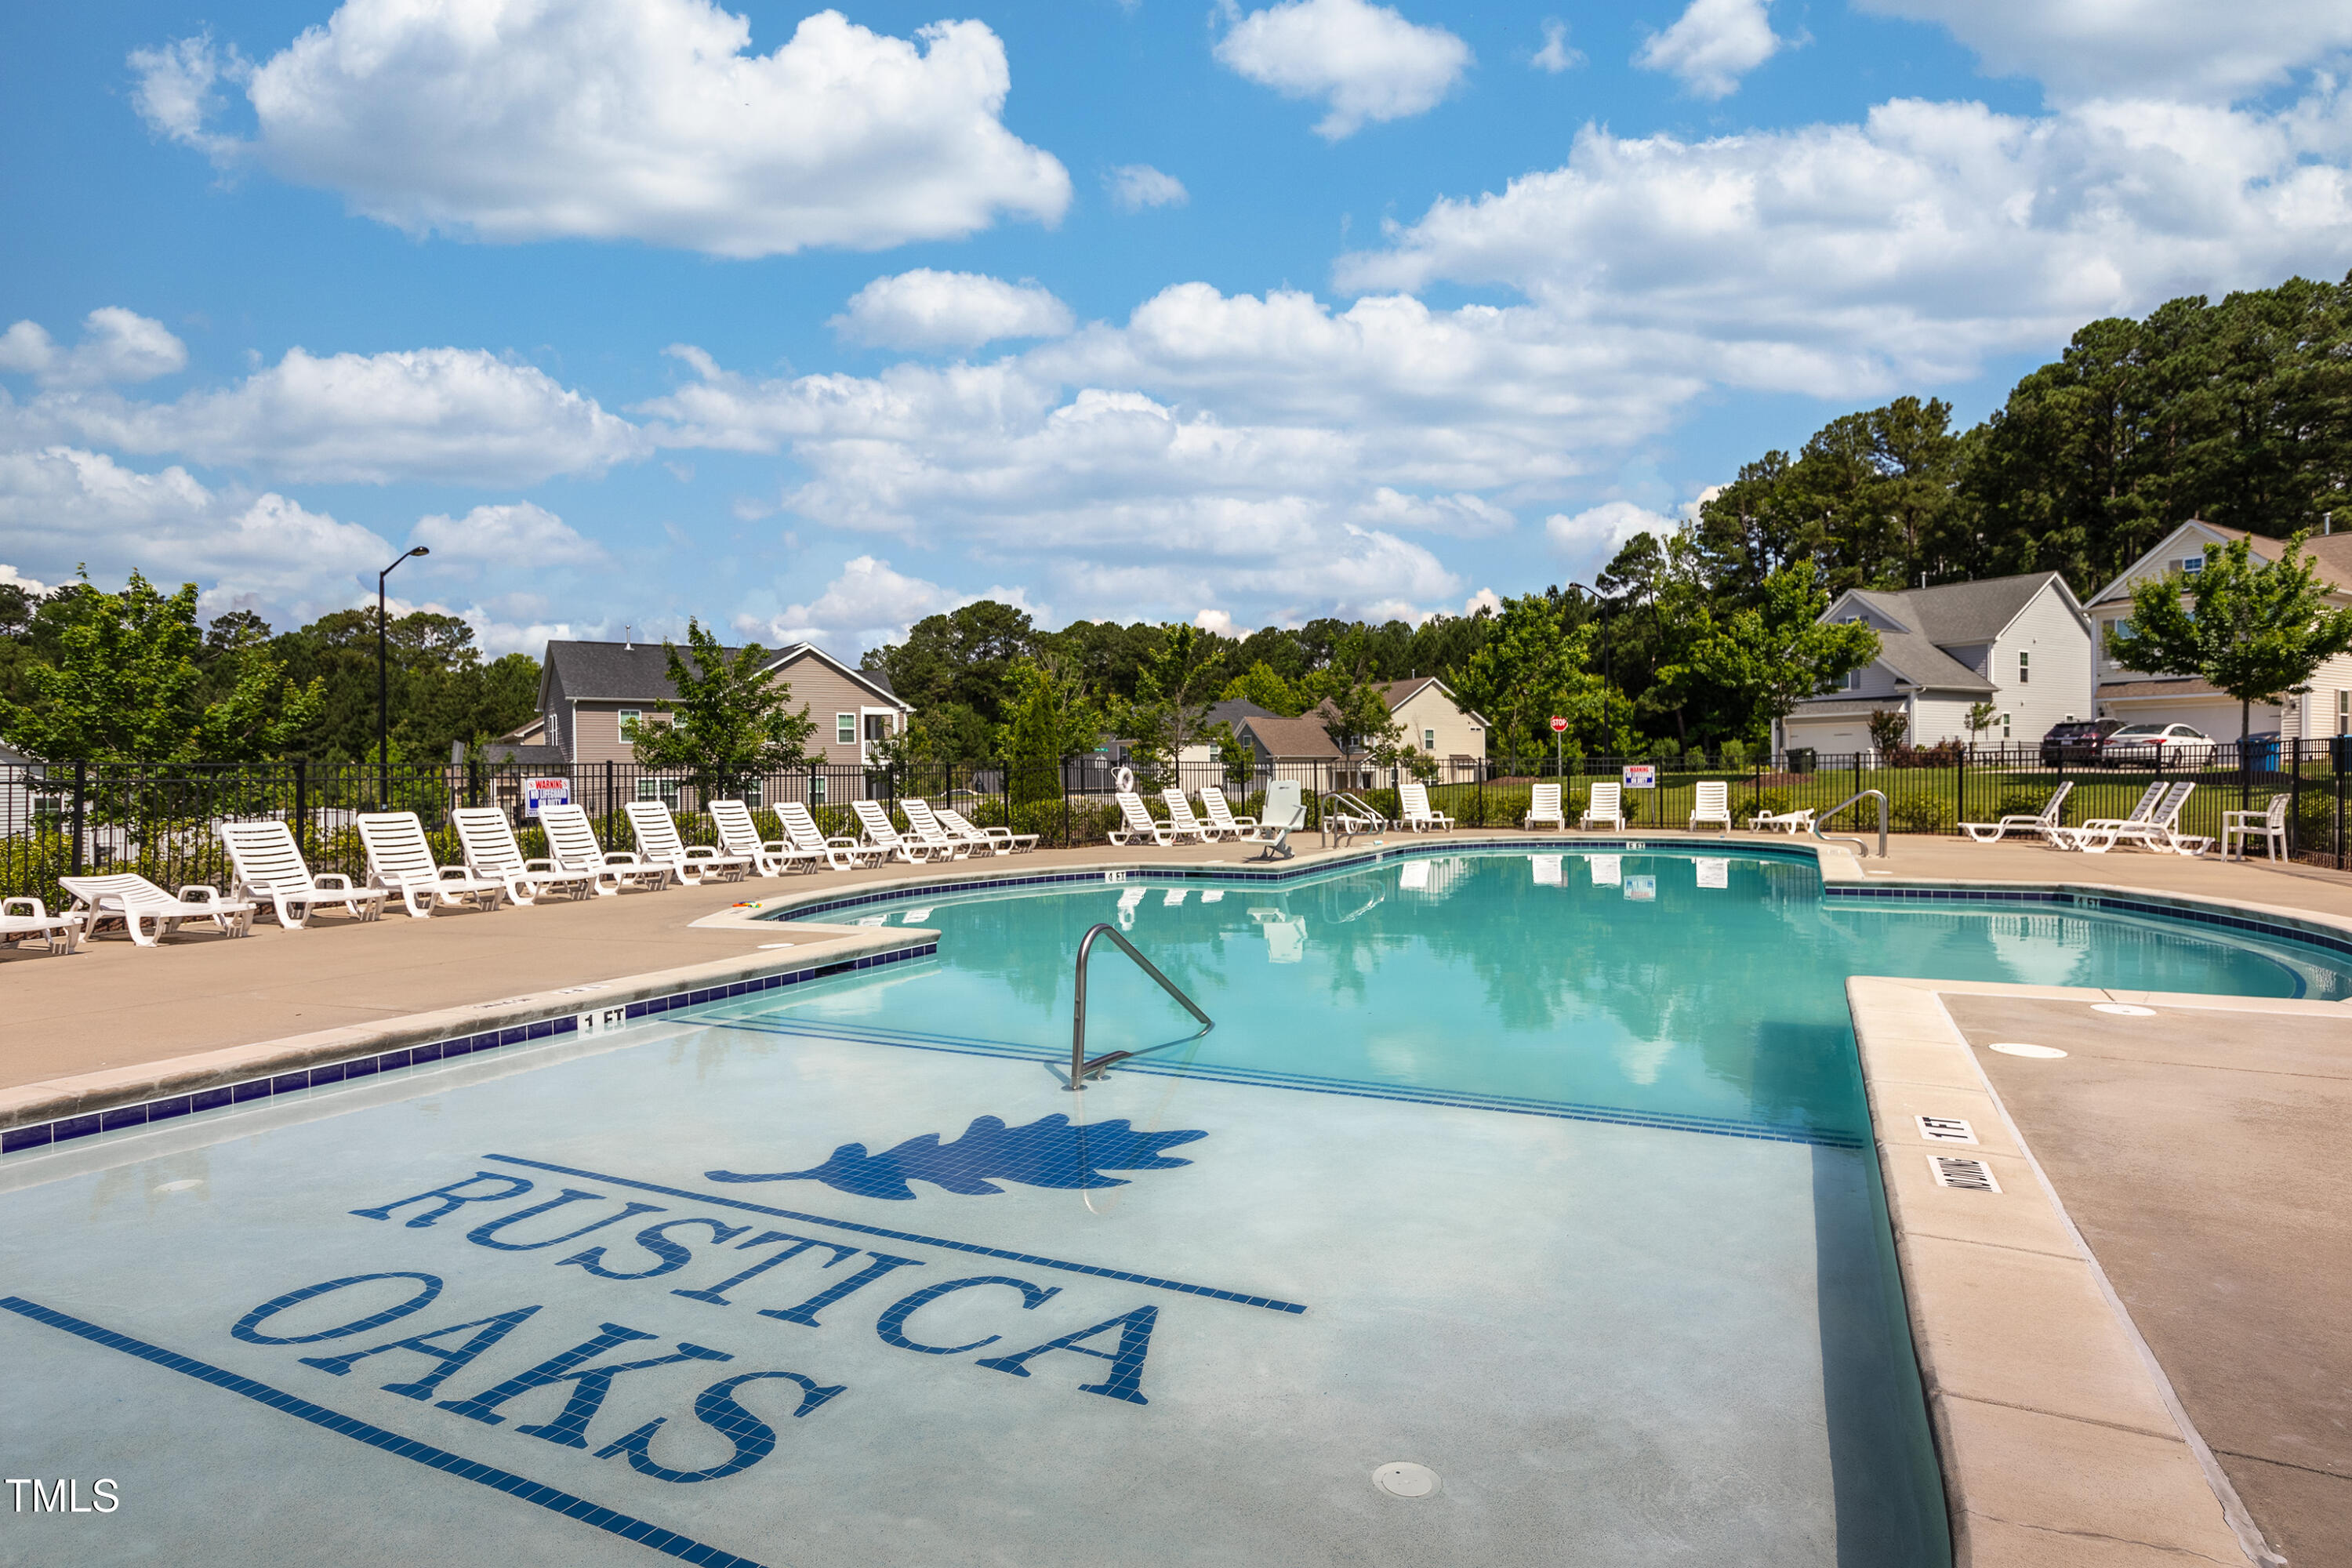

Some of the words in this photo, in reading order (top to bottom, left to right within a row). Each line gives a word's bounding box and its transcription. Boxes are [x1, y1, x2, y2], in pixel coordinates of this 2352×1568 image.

[1552, 718, 1567, 727] STOP
[535, 779, 562, 789] WARNING
[530, 789, 539, 799] NO
[541, 789, 566, 799] LIFEGUARD
[2087, 897, 2098, 906] FT
[585, 1014, 593, 1027] 1
[604, 1007, 624, 1023] FT
[1922, 1116, 1965, 1131] FT
[347, 1171, 1160, 1406] RUSTICA
[230, 1271, 848, 1483] OAKS
